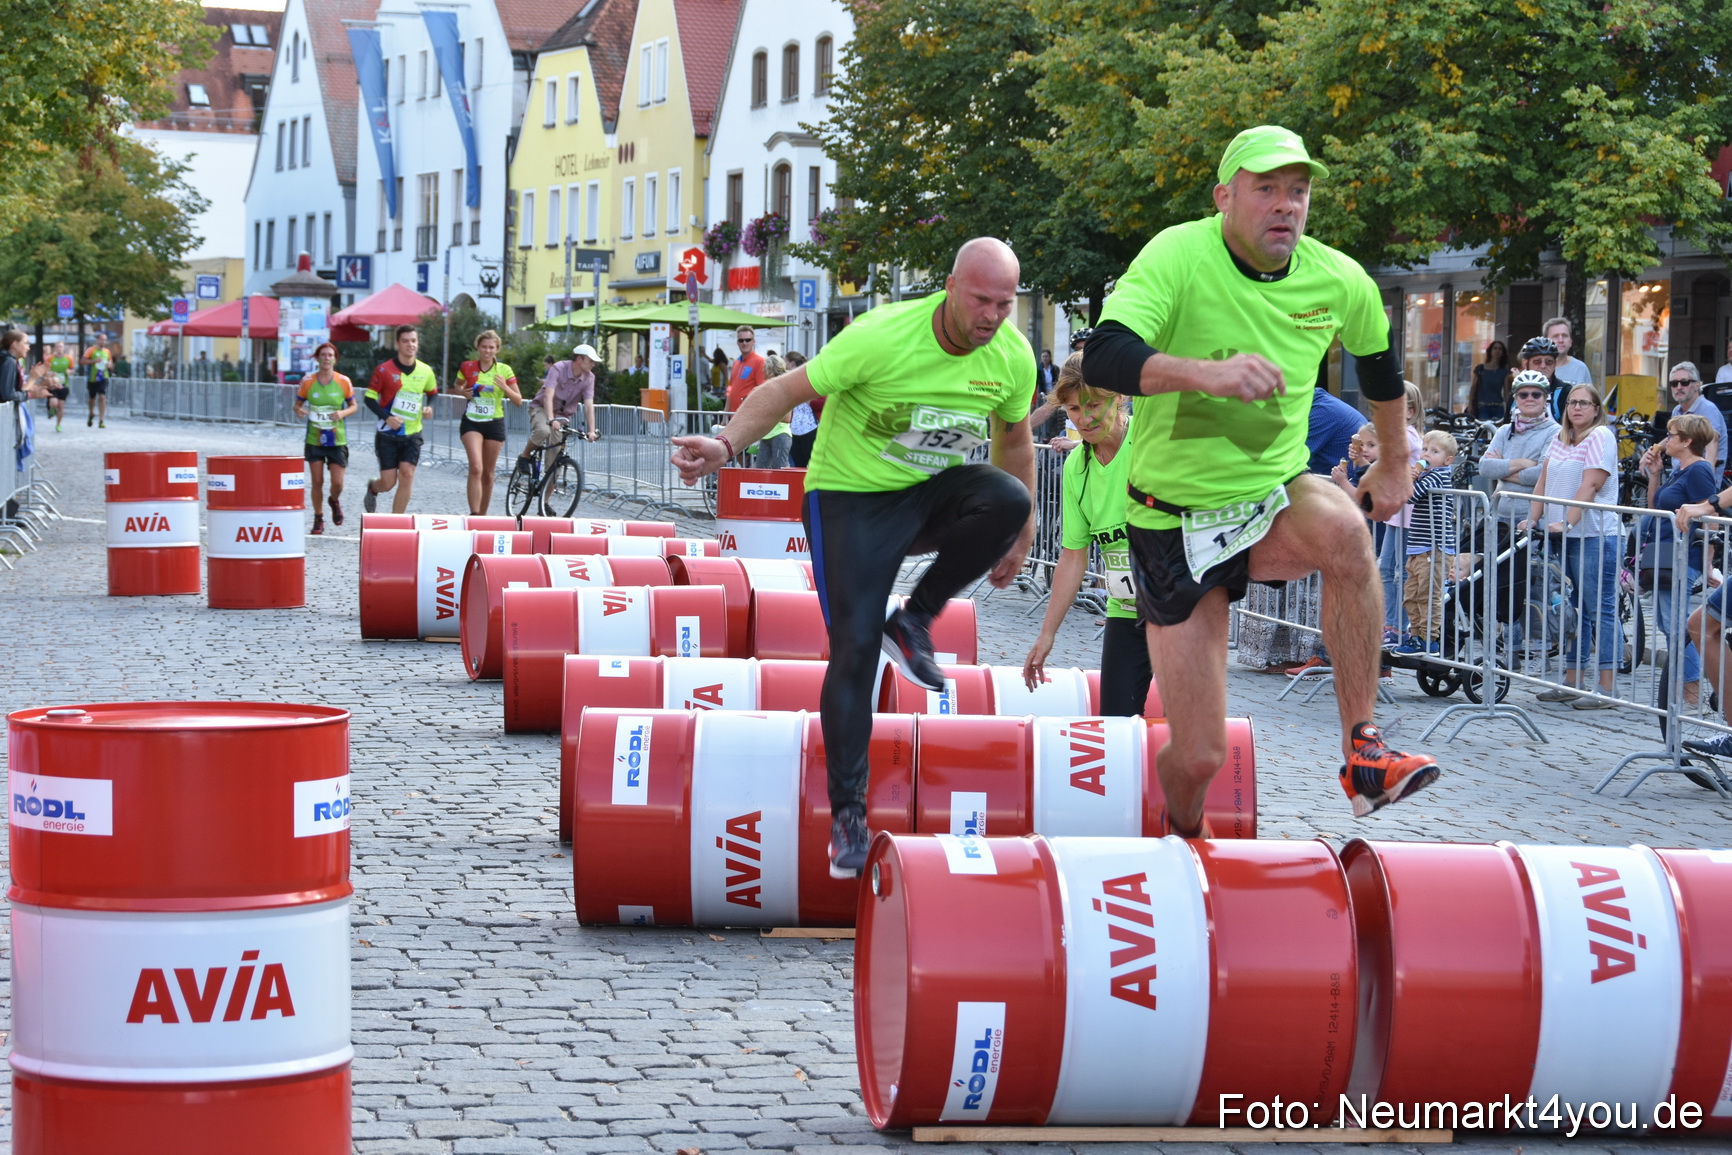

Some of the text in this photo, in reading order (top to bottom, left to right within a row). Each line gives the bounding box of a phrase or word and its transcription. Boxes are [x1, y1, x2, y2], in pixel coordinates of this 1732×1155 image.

[555, 154, 578, 177] HOTEL
[577, 262, 608, 271] TAIFN
[802, 282, 813, 306] P
[400, 400, 417, 412] 179
[474, 404, 489, 415] 180
[918, 429, 962, 449] 152
[903, 451, 949, 468] STEFAN
